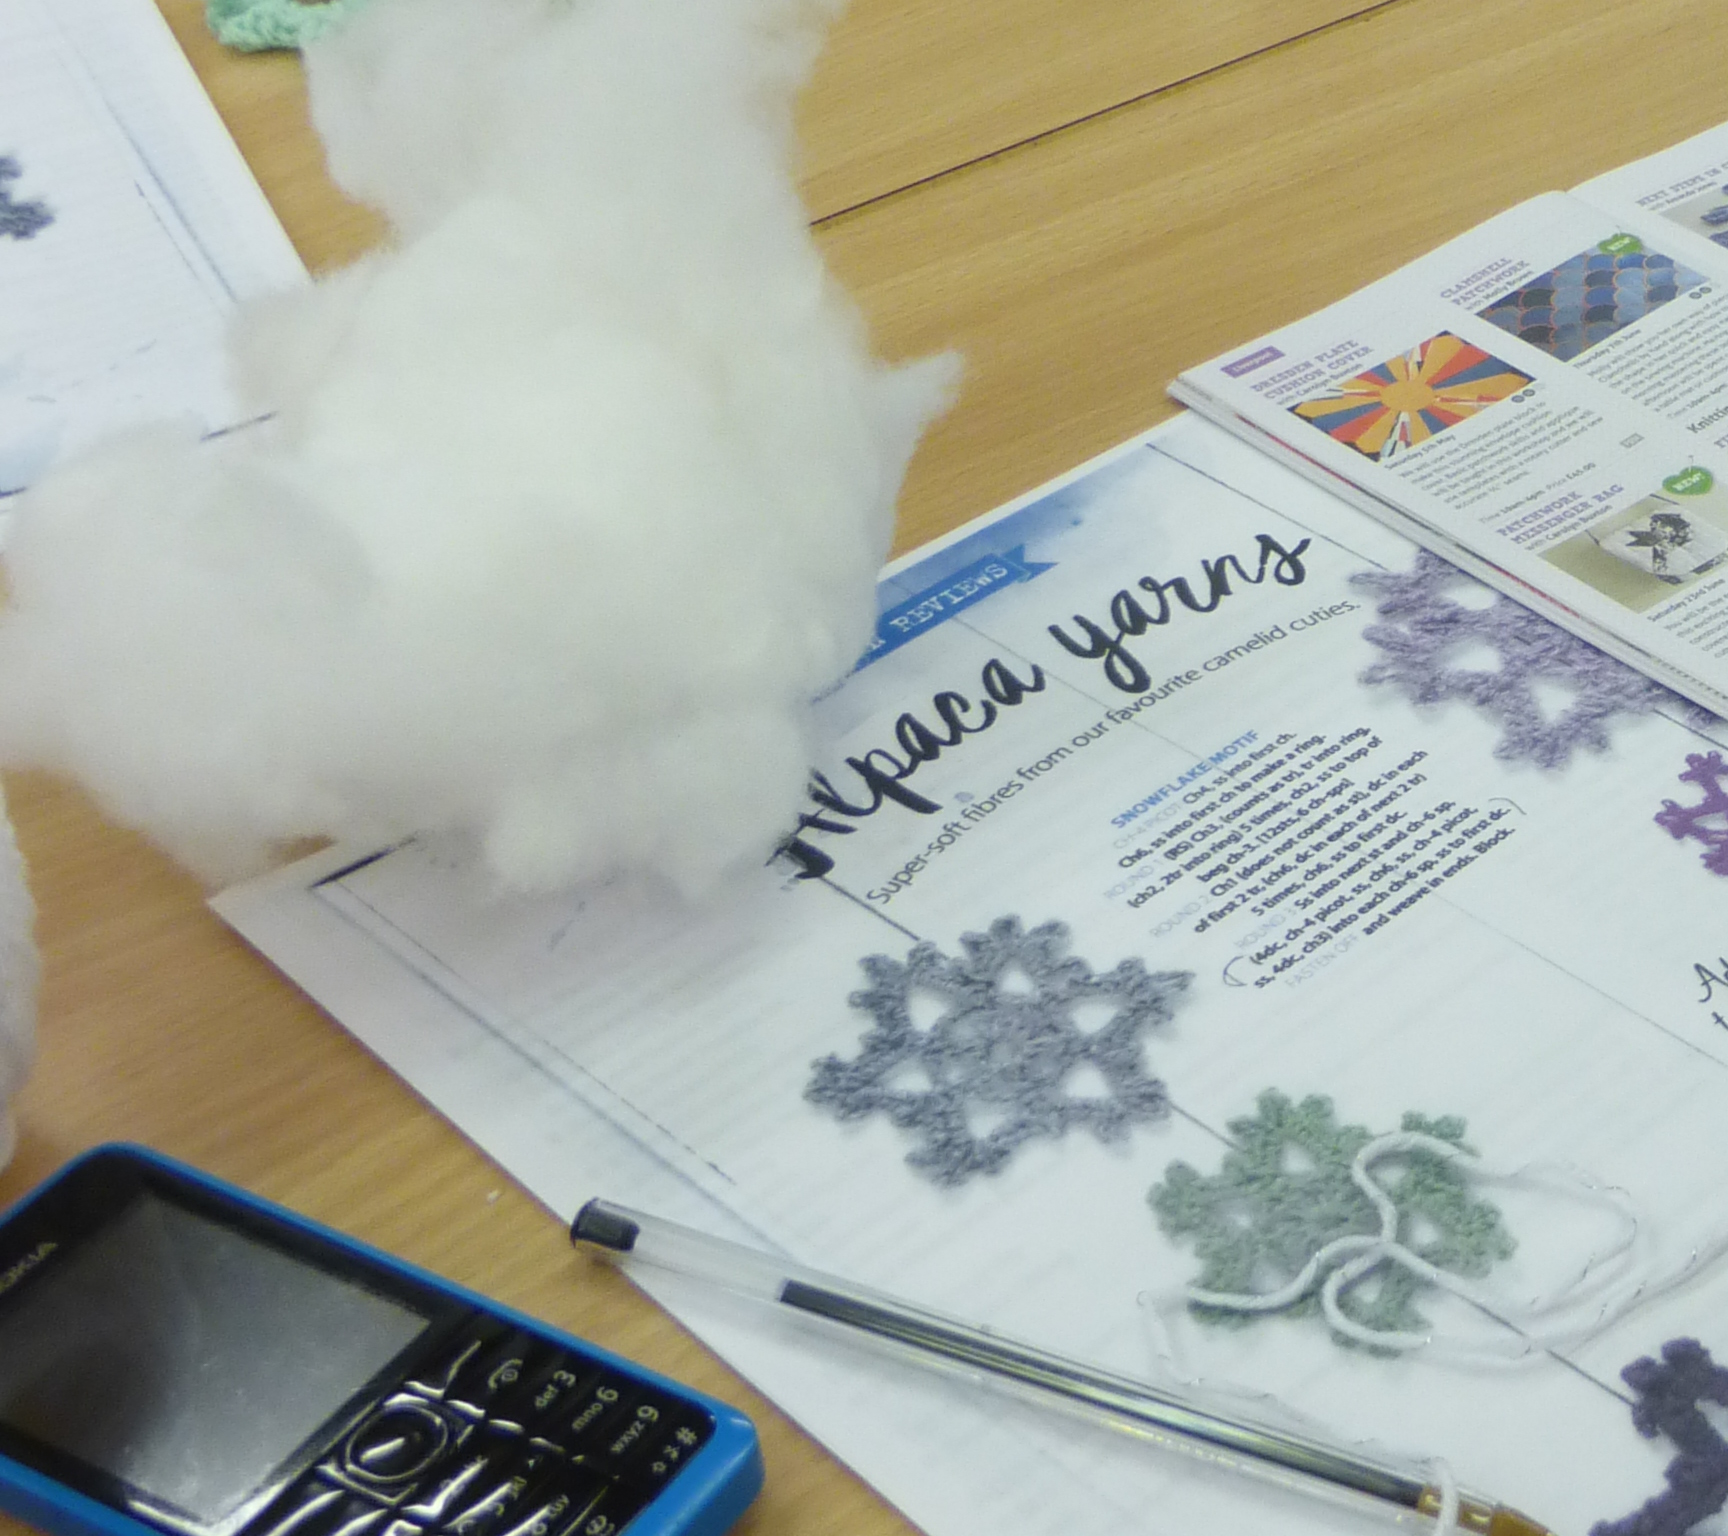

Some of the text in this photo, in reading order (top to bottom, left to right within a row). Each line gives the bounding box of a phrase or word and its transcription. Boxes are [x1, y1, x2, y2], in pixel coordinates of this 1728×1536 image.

[1495, 490, 1583, 540] PATCHWORK
[1510, 483, 1624, 545] MESSENGER BAG
[889, 561, 1009, 634] REVIEWS
[1047, 534, 1312, 694] yarns
[866, 600, 1362, 906] Super-soft fibres from our favourite camelid cuties.
[1110, 729, 1258, 828] SNOWFLAKE MOTIF
[1117, 734, 1326, 868] Ch6, into first make ring.
[1162, 743, 1341, 861] (RS) Ch3, (counts into
[1181, 732, 1297, 804] Ch4, into first ch.
[1159, 746, 1369, 886] 2tr into ring) ch2, top
[1195, 842, 1260, 883] beg ch-3.
[1206, 790, 1402, 922] first (ch6, each next
[1209, 750, 1428, 897] Ch1 (does not count each
[1260, 810, 1408, 909] times, ch6, first dc.
[1308, 810, 1436, 899] into next and ch-6
[1248, 828, 1443, 965] (4dc, ch-4 ss, ch6, ss, ch-4
[1253, 807, 1511, 988] ss, 4dc, ch3) into each ch-6 first dc.
[1361, 827, 1515, 935] and weave ends. Block.
[571, 1386, 619, 1432] mno 6
[637, 1404, 660, 1424] 9
